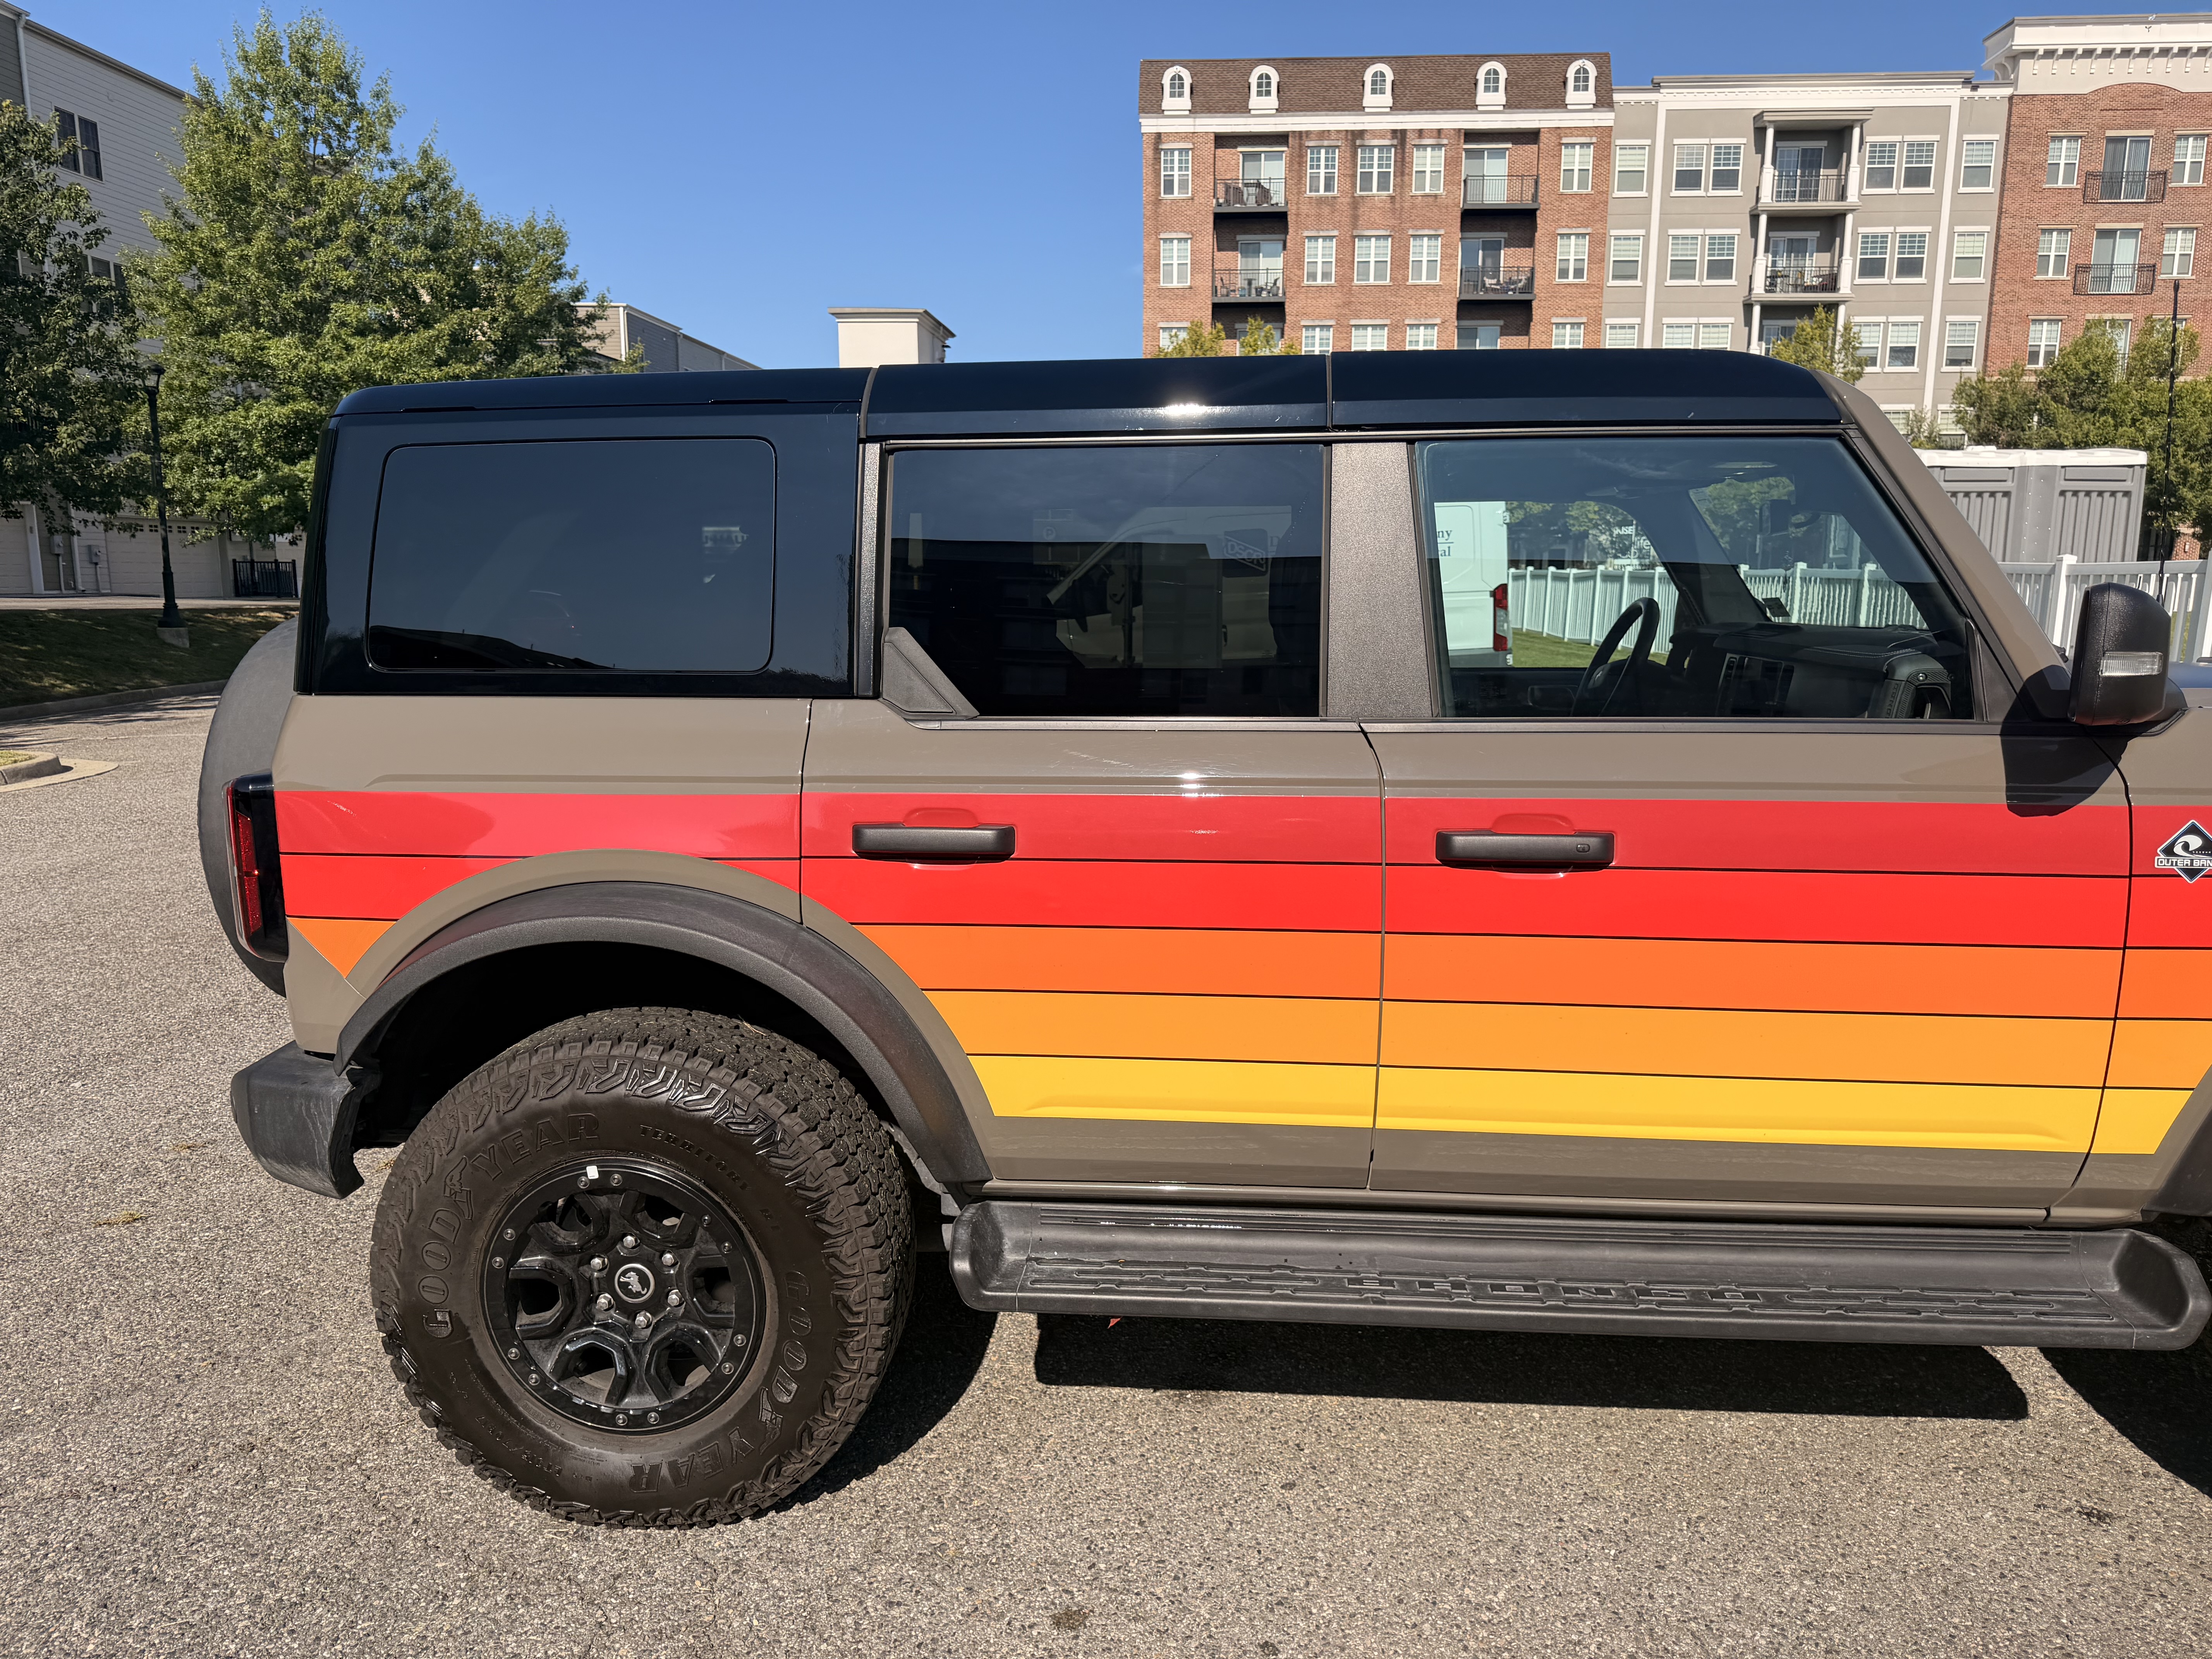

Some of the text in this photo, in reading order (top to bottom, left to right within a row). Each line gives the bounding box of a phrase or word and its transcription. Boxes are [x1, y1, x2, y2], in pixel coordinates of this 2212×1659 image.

[1437, 530, 1453, 541] ny
[1439, 546, 1451, 556] al
[640, 1125, 752, 1190] TERRITORY
[1345, 1278, 1762, 1302] BRONCO
[546, 1419, 561, 1431] DOT
